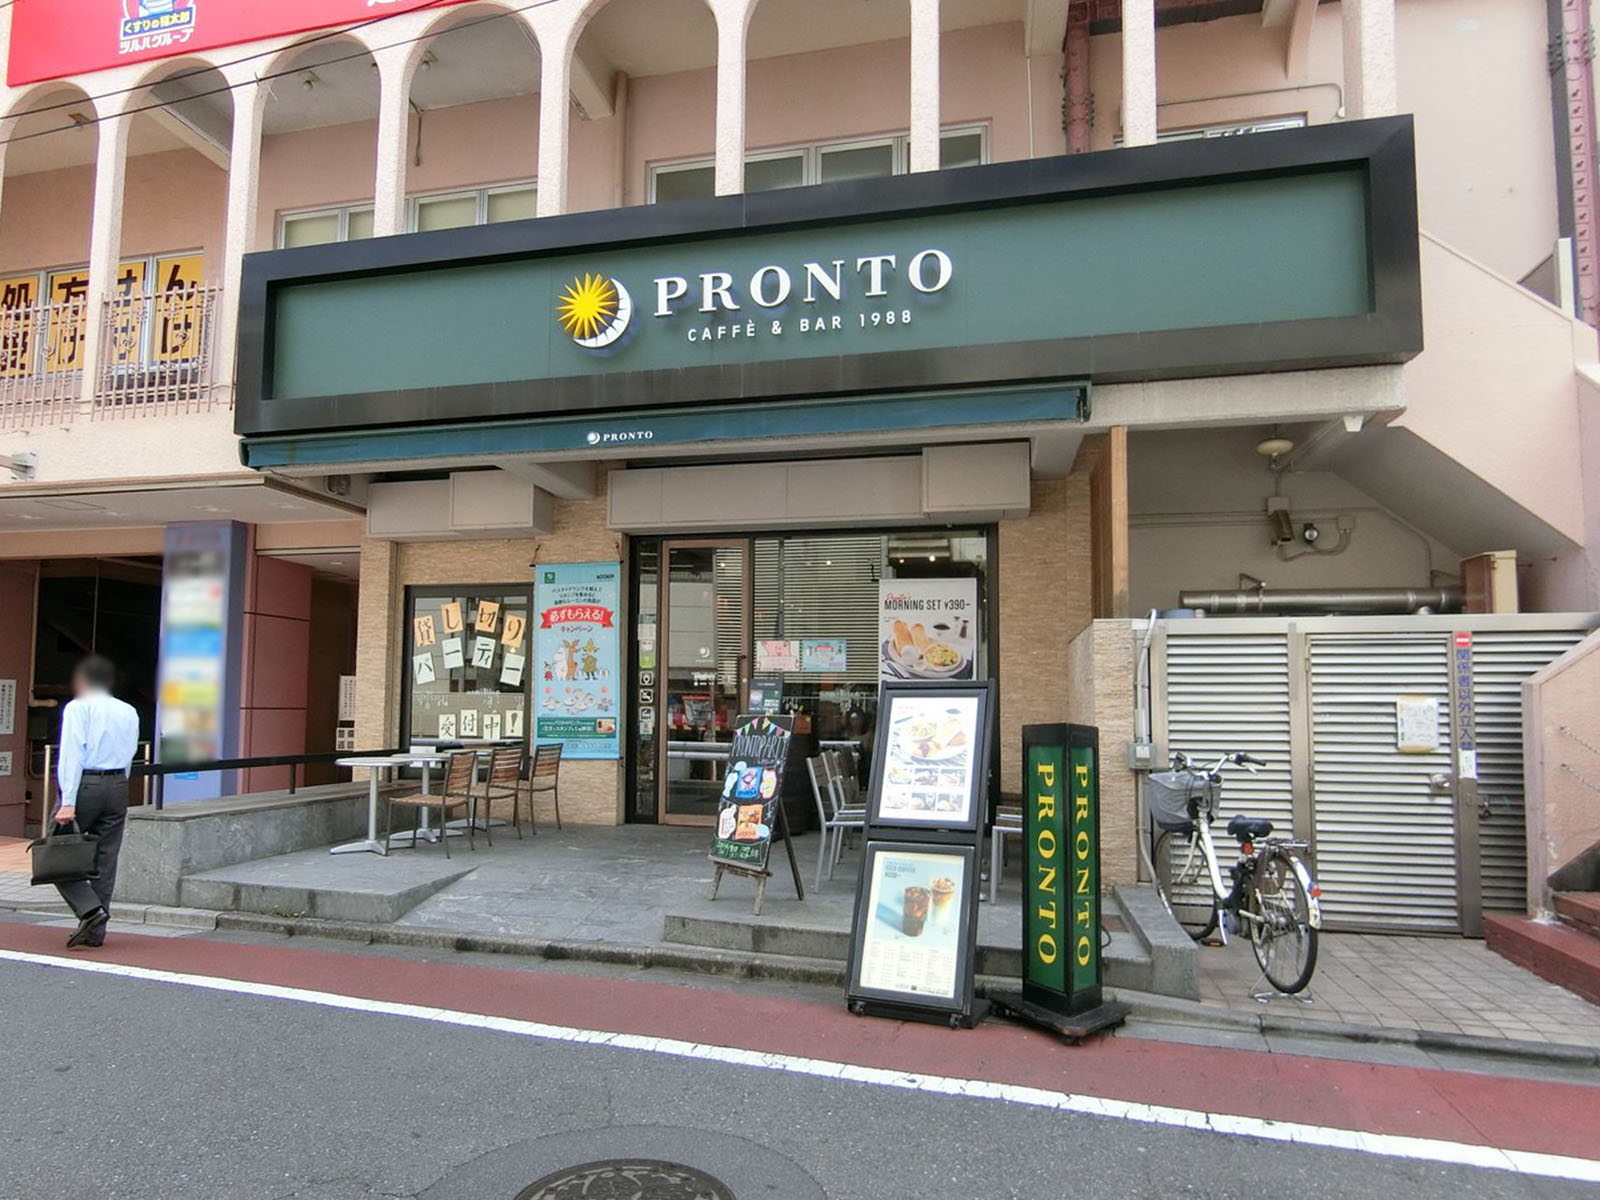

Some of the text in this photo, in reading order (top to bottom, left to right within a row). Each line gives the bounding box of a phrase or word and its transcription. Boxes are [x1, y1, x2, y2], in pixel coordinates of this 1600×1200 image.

[653, 249, 953, 317] PRONTO
[688, 310, 912, 341] CAFFÈ & BAR 1988
[603, 431, 653, 442] PRONTO
[884, 599, 924, 611] MORNING
[926, 599, 942, 611] SET
[416, 607, 522, 646] 貸し切り
[418, 642, 521, 674] パーティー
[1037, 762, 1057, 964] PRONTO
[1075, 764, 1091, 966] PRONTO
